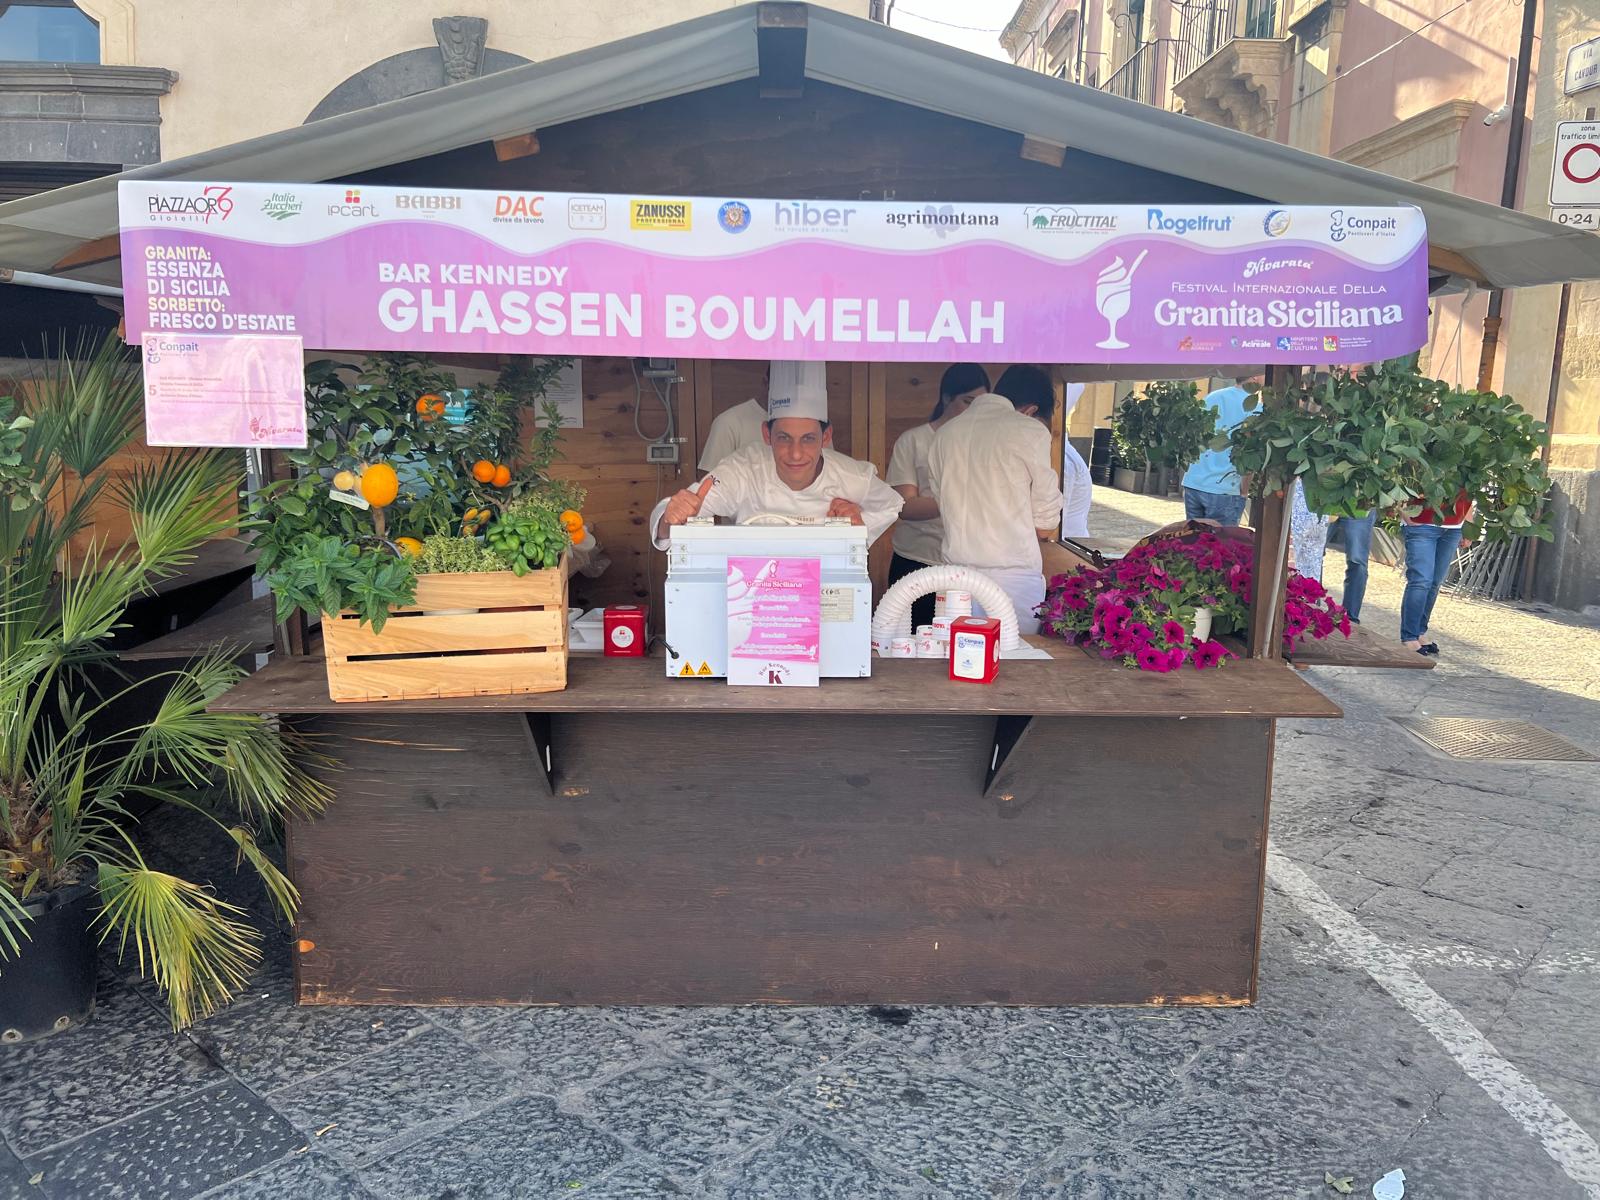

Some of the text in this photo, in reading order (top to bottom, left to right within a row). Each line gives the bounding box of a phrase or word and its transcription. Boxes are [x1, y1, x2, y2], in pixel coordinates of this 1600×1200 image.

[1583, 47, 1593, 60] VIA
[1574, 63, 1598, 81] CAVOUR
[271, 192, 296, 203] Italia
[395, 195, 462, 210] BABBI
[260, 199, 303, 212] Zuccheri
[495, 195, 545, 217] DAC
[571, 204, 603, 212] ICETEAM
[636, 203, 686, 219] ZANUSSI
[149, 214, 205, 223] Gioielli
[775, 202, 857, 226] hiber
[885, 210, 999, 228] agrimontana
[1049, 215, 1117, 228] FRUCTITAL
[1147, 208, 1233, 235] Rogelfrut
[1558, 213, 1593, 225] 0-24
[1347, 216, 1397, 231] Conpait
[145, 246, 211, 261] GRANITA:
[146, 261, 224, 278] ESSENZA
[379, 263, 568, 286] BAR KENNEDY
[147, 279, 230, 297] DI SICILIA
[1172, 282, 1387, 295] FESTIVAL INTERNAZIONALE DELLA
[148, 297, 225, 313] SORBETTO:
[378, 287, 1005, 345] GHASSEN BOUMELLAH
[1154, 298, 1403, 328] Granita Siciliana
[149, 313, 296, 331] FRESCO D'ESTATE
[159, 340, 199, 352] Conpait
[1241, 339, 1271, 348] Acireale
[149, 384, 157, 396] 5
